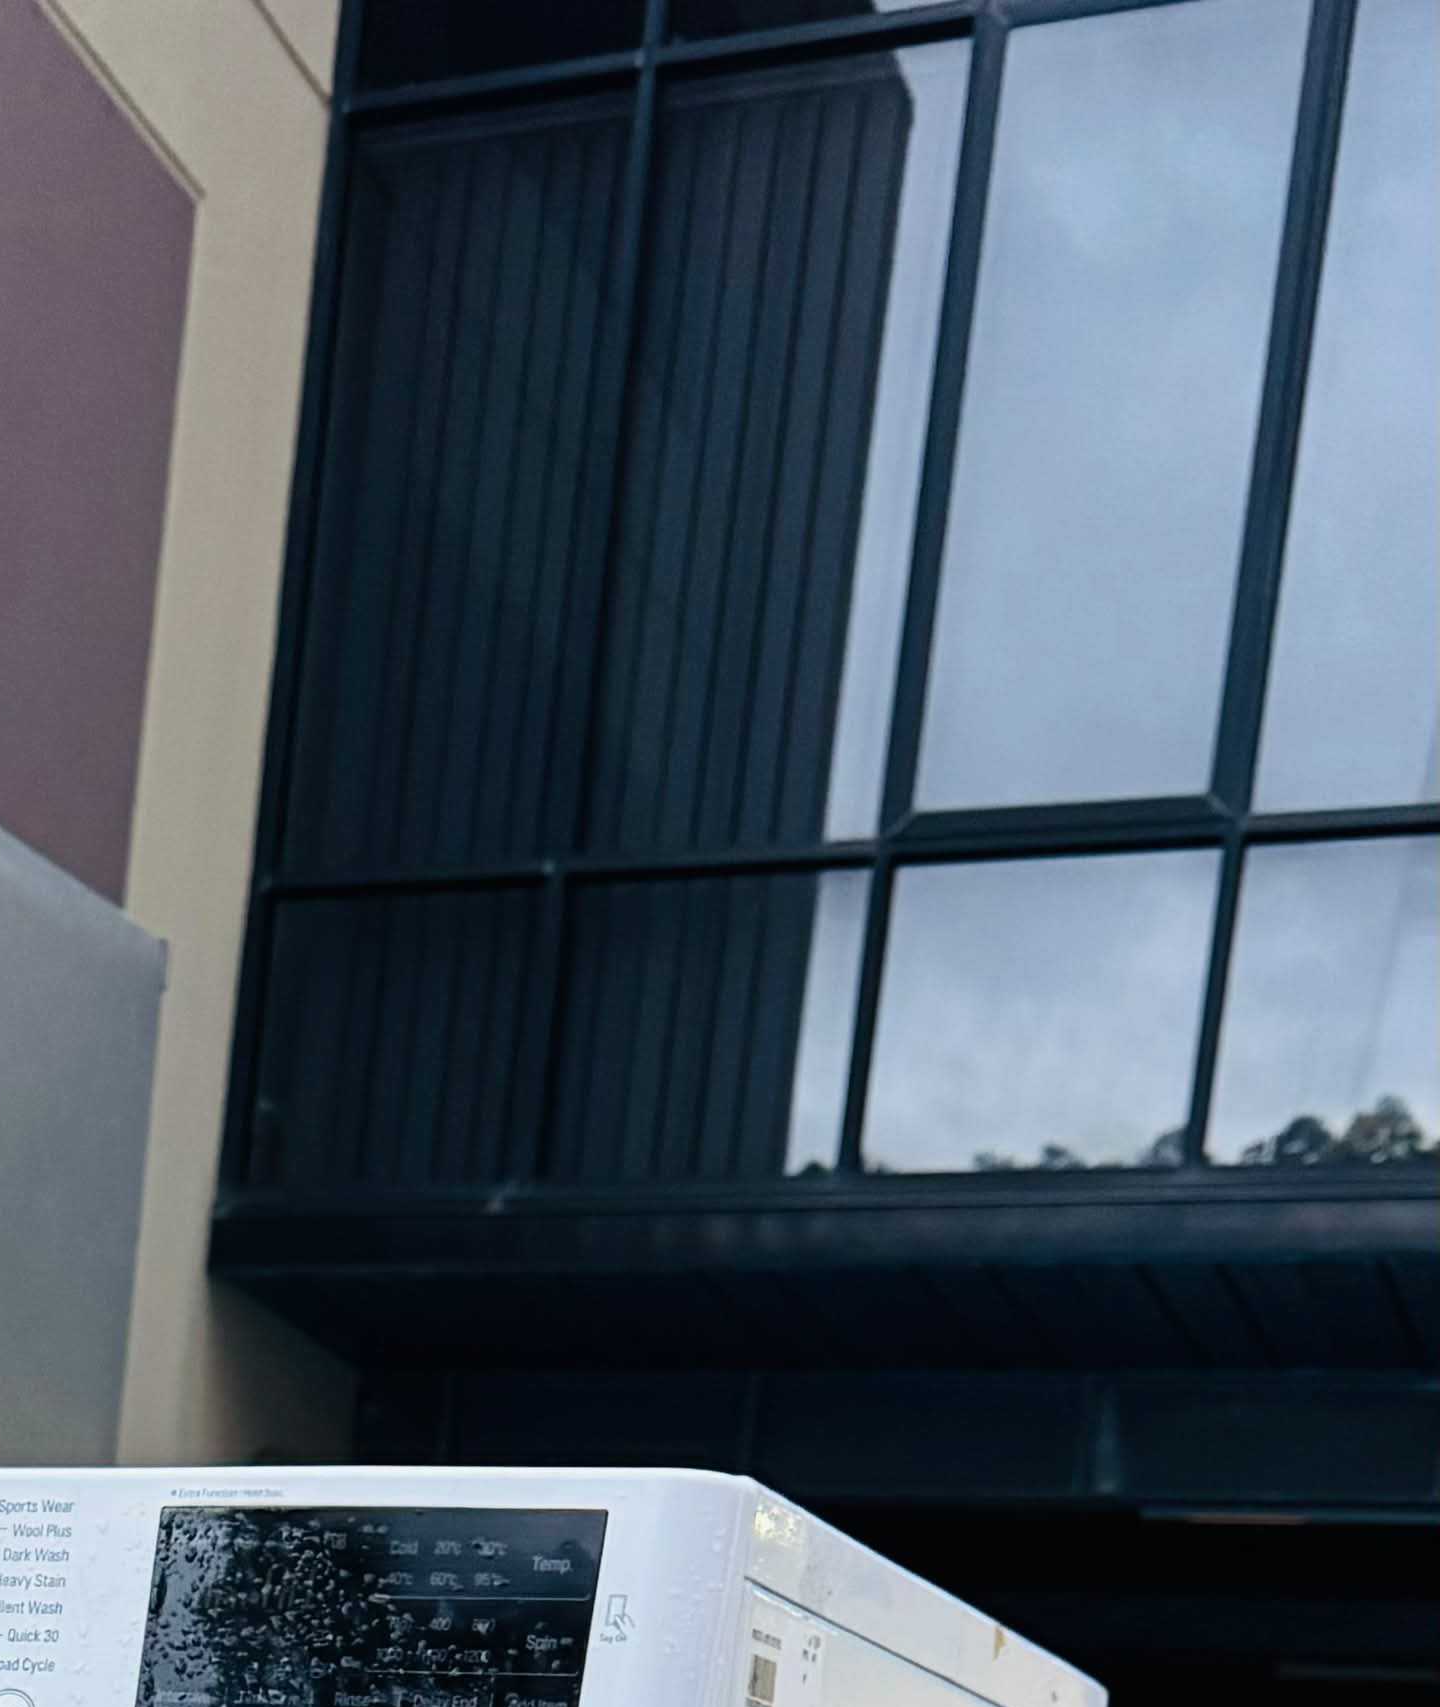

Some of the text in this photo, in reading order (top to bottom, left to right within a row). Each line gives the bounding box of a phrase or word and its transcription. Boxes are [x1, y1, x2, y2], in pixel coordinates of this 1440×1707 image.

[41, 1500, 75, 1512] Wear
[12, 1524, 72, 1538] Wool Plus
[3, 1548, 69, 1562] Dark Wash
[31, 1574, 66, 1587] Stain
[26, 1601, 63, 1615] Wash
[7, 1628, 59, 1643] Quick 30
[526, 1634, 558, 1652] Spin
[21, 1658, 55, 1674] Cycle
